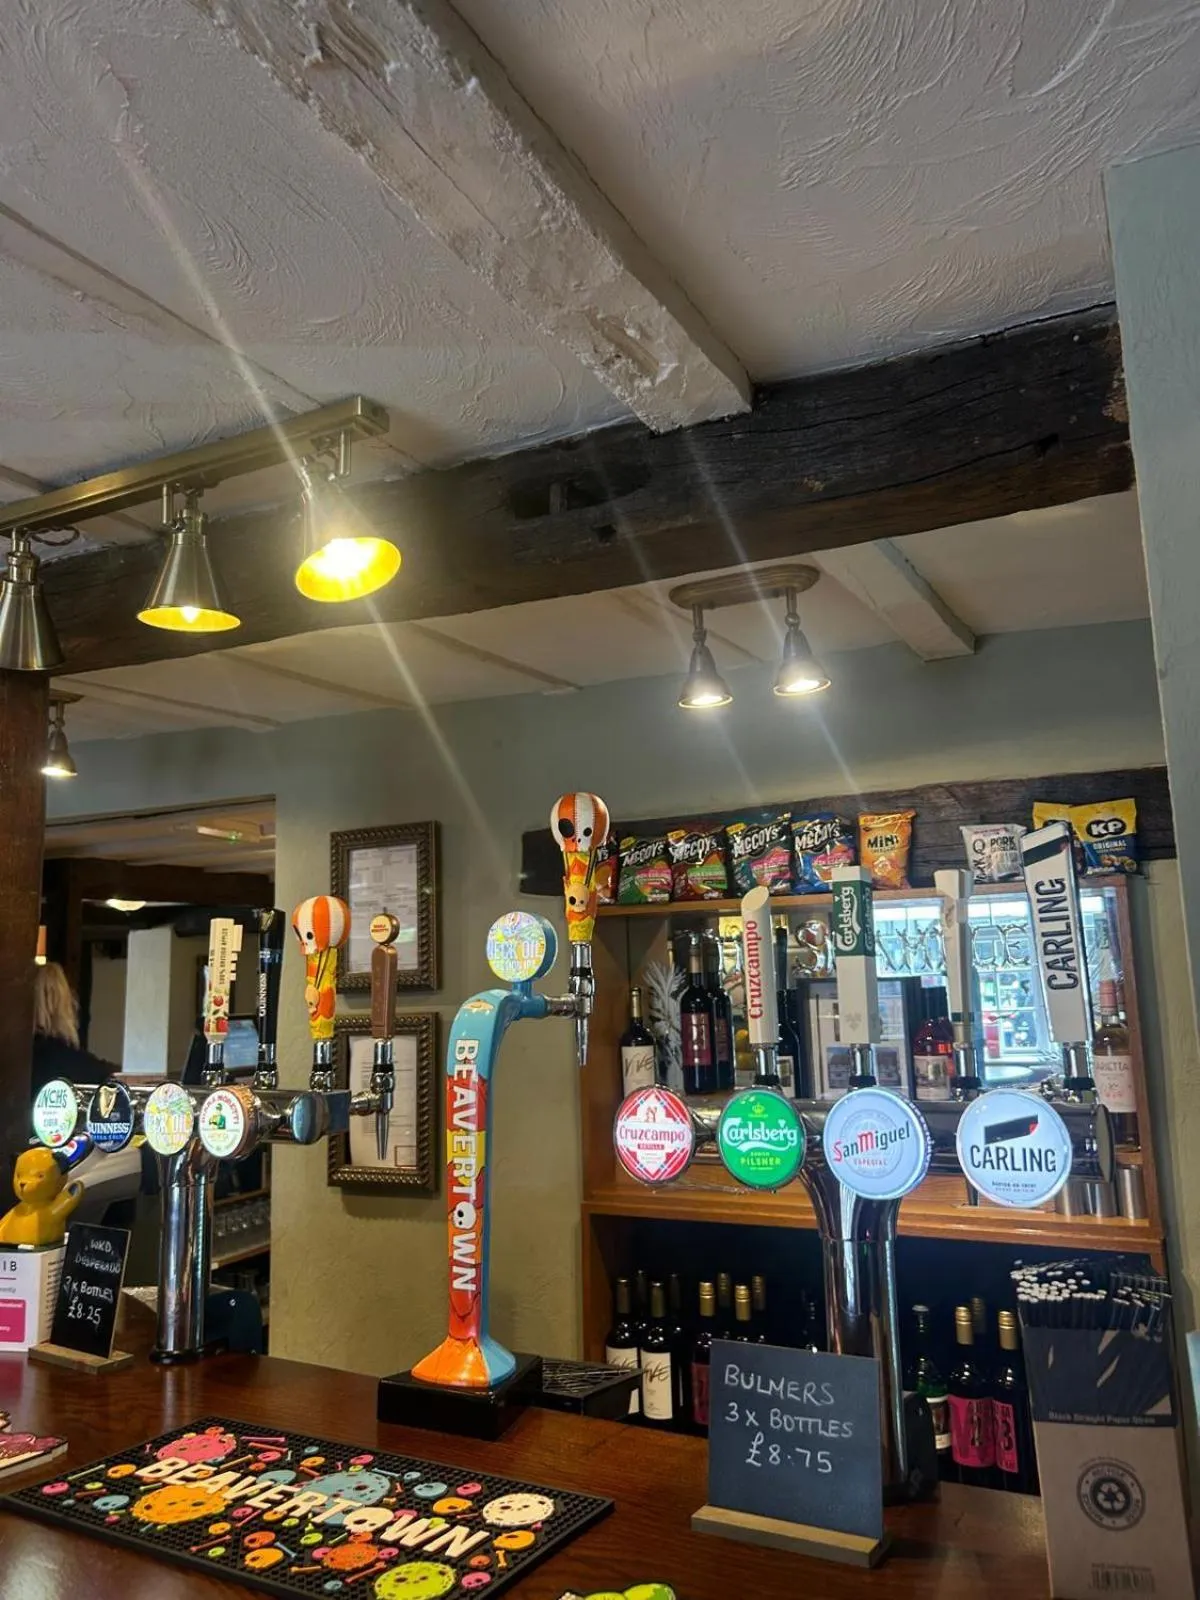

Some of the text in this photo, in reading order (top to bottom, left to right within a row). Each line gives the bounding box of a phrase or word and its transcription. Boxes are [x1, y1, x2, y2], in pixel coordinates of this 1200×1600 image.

[1090, 820, 1123, 837] KP
[836, 885, 860, 951] Carlsberg
[1034, 877, 1079, 991] CARLING
[745, 920, 764, 1020] Cruzcampo
[259, 972, 267, 1018] GUINNESS
[619, 1124, 685, 1145] Cruzcampo
[722, 1117, 798, 1148] Carlsberg
[740, 1156, 781, 1166] PILSNER
[970, 1144, 1057, 1173] CARLING
[66, 1295, 103, 1325] £8.25
[724, 1363, 835, 1406] BULMERS
[725, 1401, 740, 1422] 3
[769, 1407, 854, 1438] BOTTLES
[745, 1431, 833, 1474] £8.75
